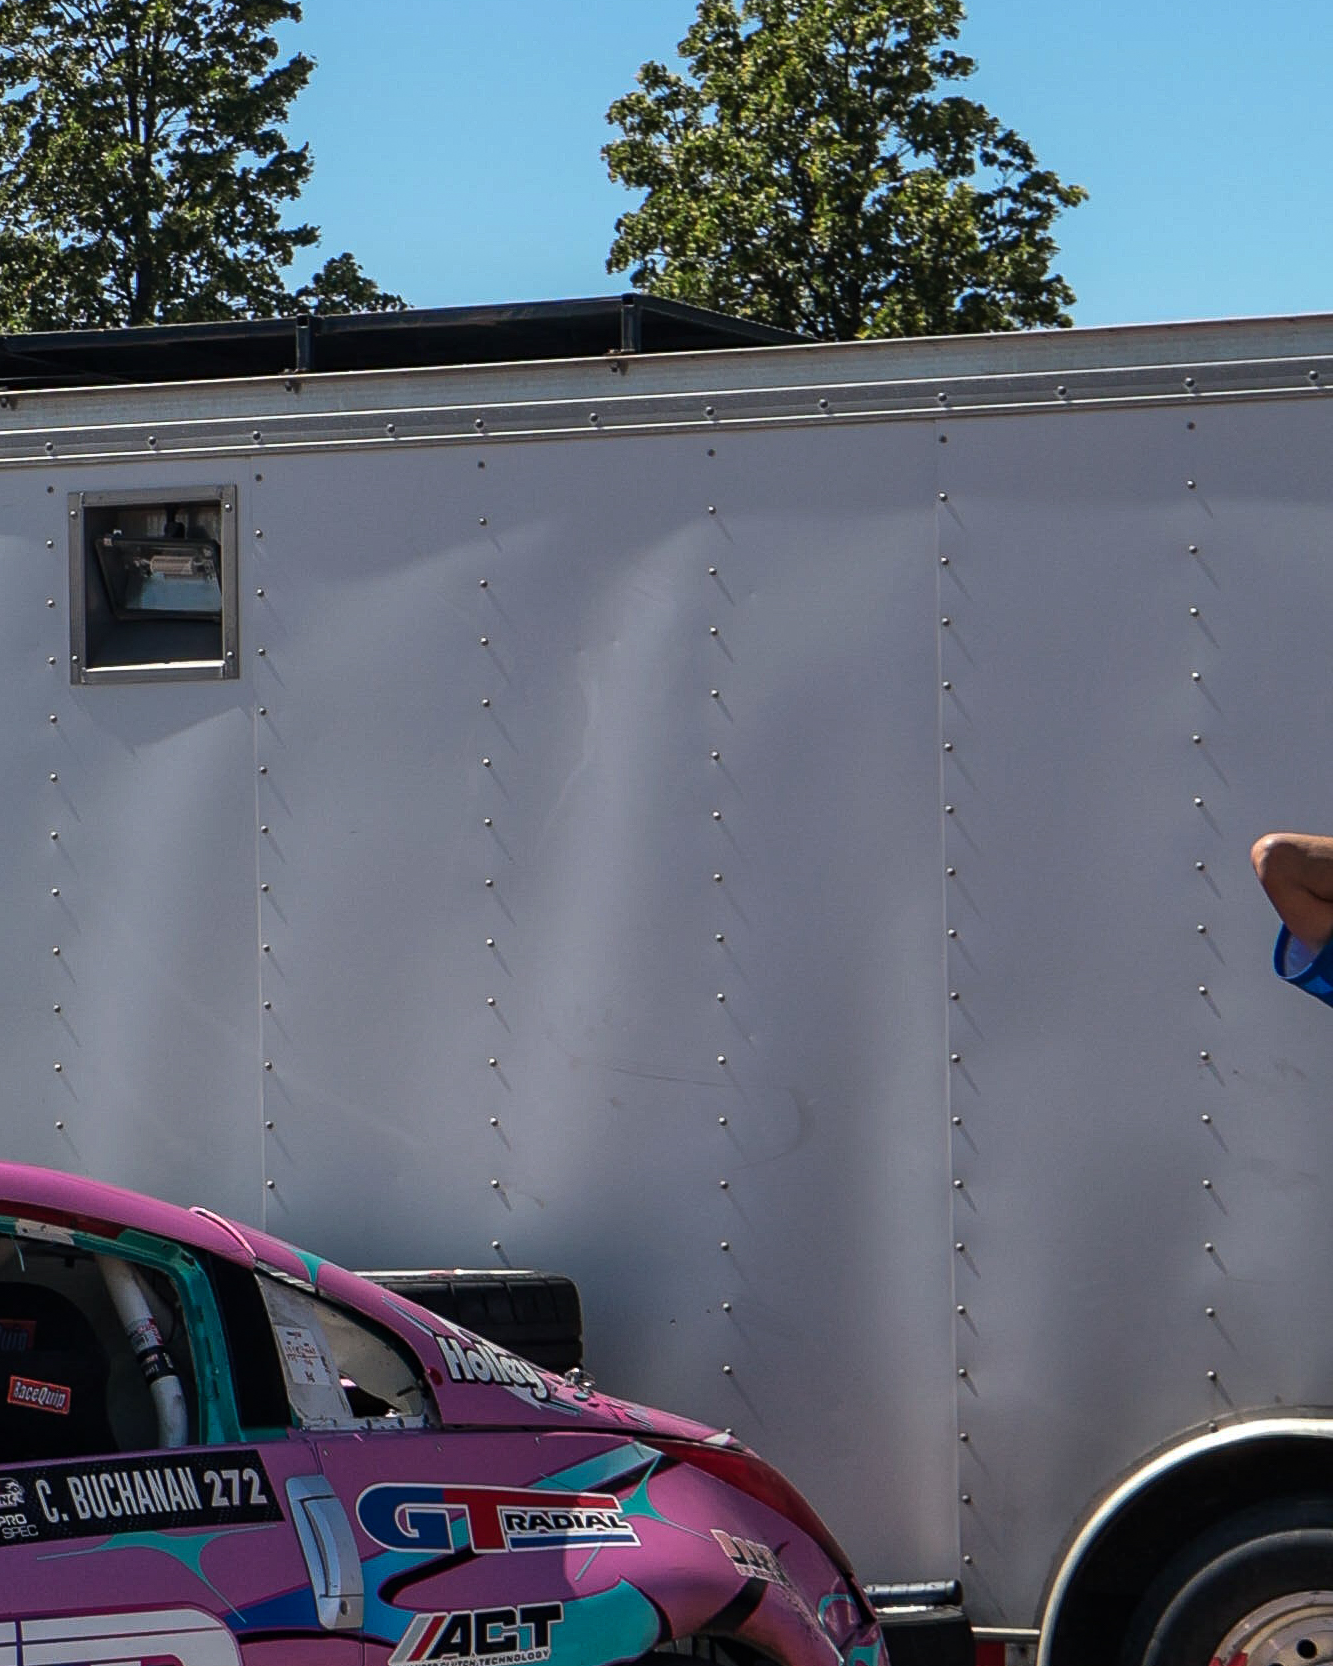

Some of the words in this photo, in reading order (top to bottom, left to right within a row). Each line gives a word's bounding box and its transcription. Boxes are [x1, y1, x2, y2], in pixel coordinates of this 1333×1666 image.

[435, 1335, 550, 1400] Holley
[12, 1381, 67, 1410] RaceQuip
[35, 1479, 69, 1523] C.
[67, 1467, 202, 1520] BUCHANAN
[203, 1468, 268, 1507] 272
[2, 1524, 40, 1539] SPEC
[505, 1512, 631, 1533] RADIAL
[430, 1604, 563, 1659] ACT
[478, 1649, 549, 1666] TECHNOLOGY
